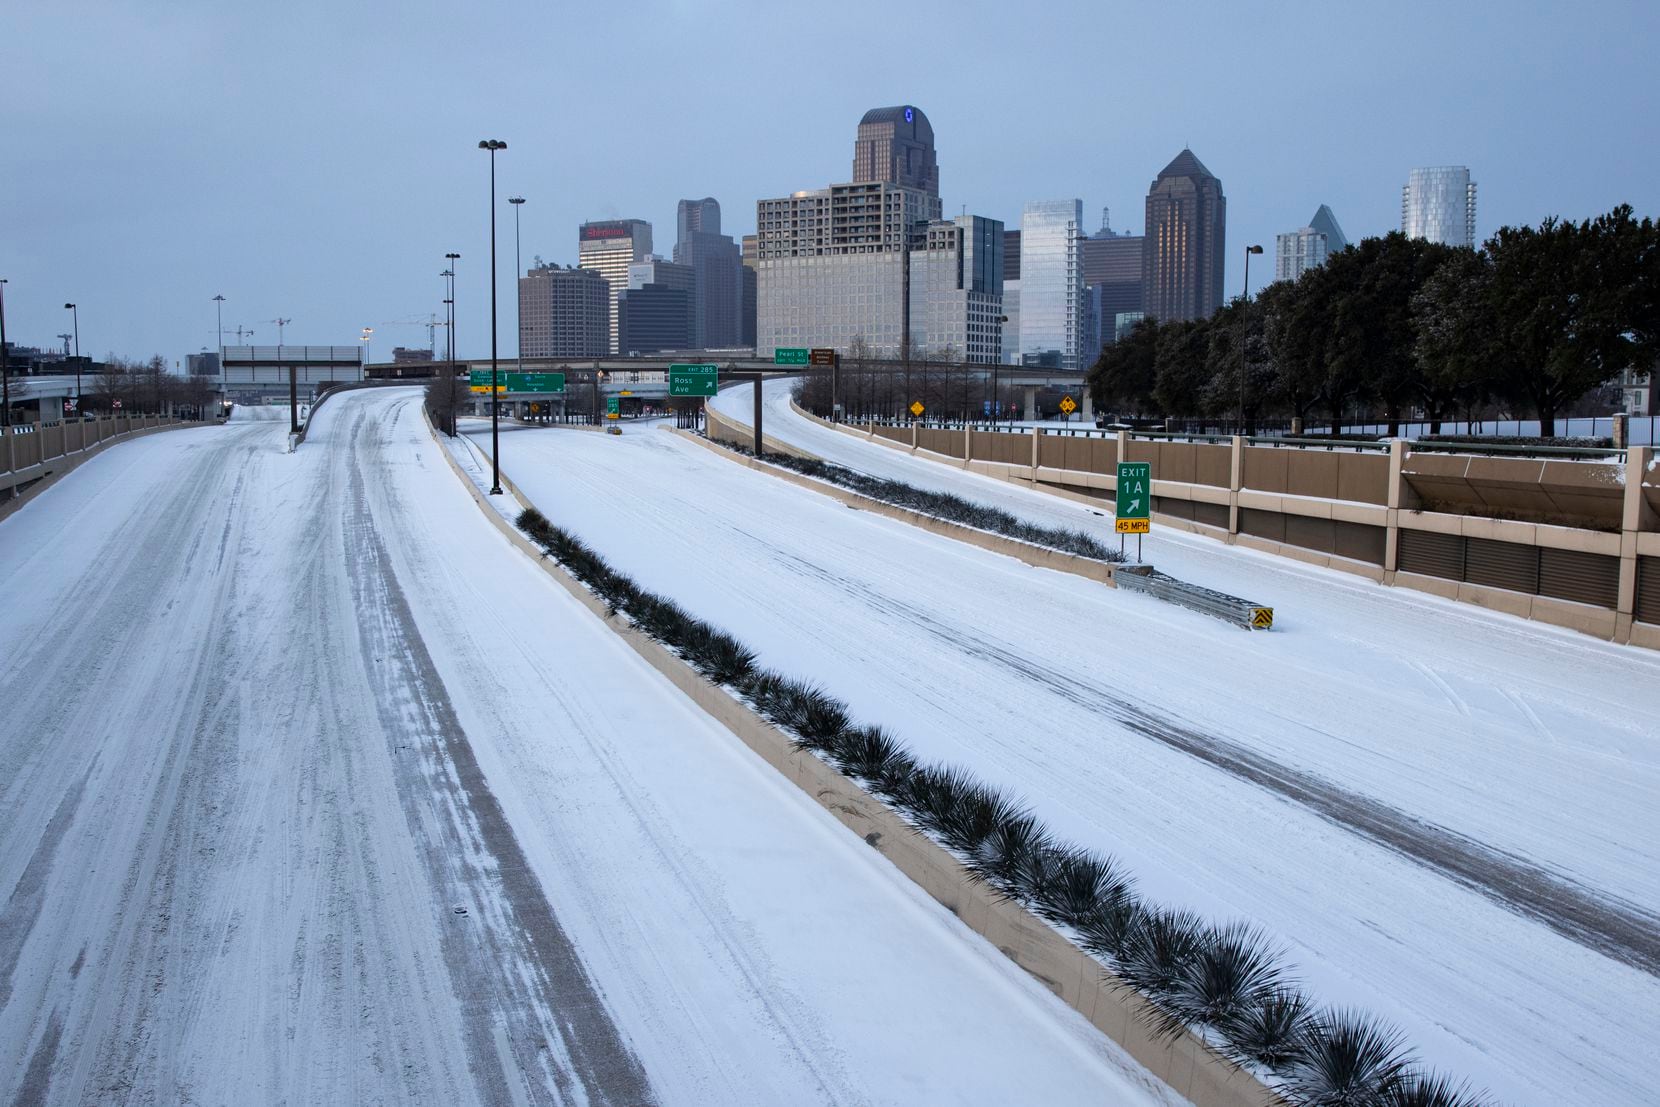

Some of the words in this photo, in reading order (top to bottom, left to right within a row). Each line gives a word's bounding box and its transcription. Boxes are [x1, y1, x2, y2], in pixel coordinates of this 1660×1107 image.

[674, 385, 690, 393] Ave
[1121, 468, 1146, 477] EXIT
[1118, 522, 1129, 530] 45
[1131, 522, 1148, 530] MPH
